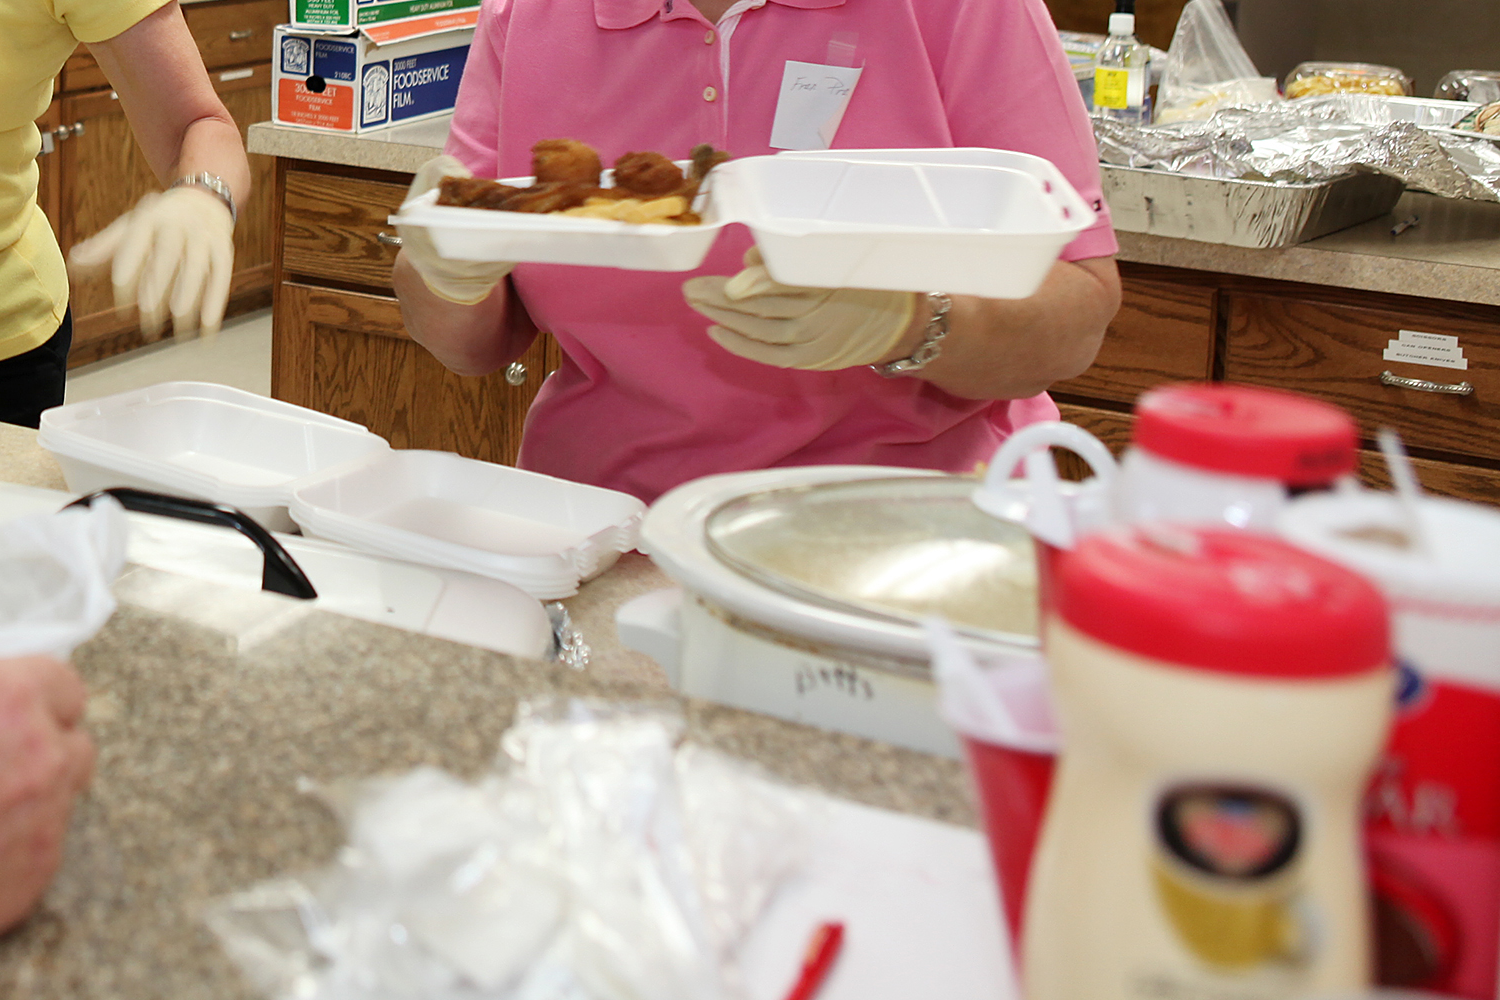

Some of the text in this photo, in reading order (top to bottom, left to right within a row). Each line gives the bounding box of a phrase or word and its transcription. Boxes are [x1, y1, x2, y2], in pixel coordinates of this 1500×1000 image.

[316, 43, 354, 54] FOODSERVICE
[394, 58, 417, 71] 3000 FEET
[393, 64, 450, 90] FOODSERVICE
[296, 95, 333, 106] FOODSERVICE
[393, 91, 412, 109] FILM
